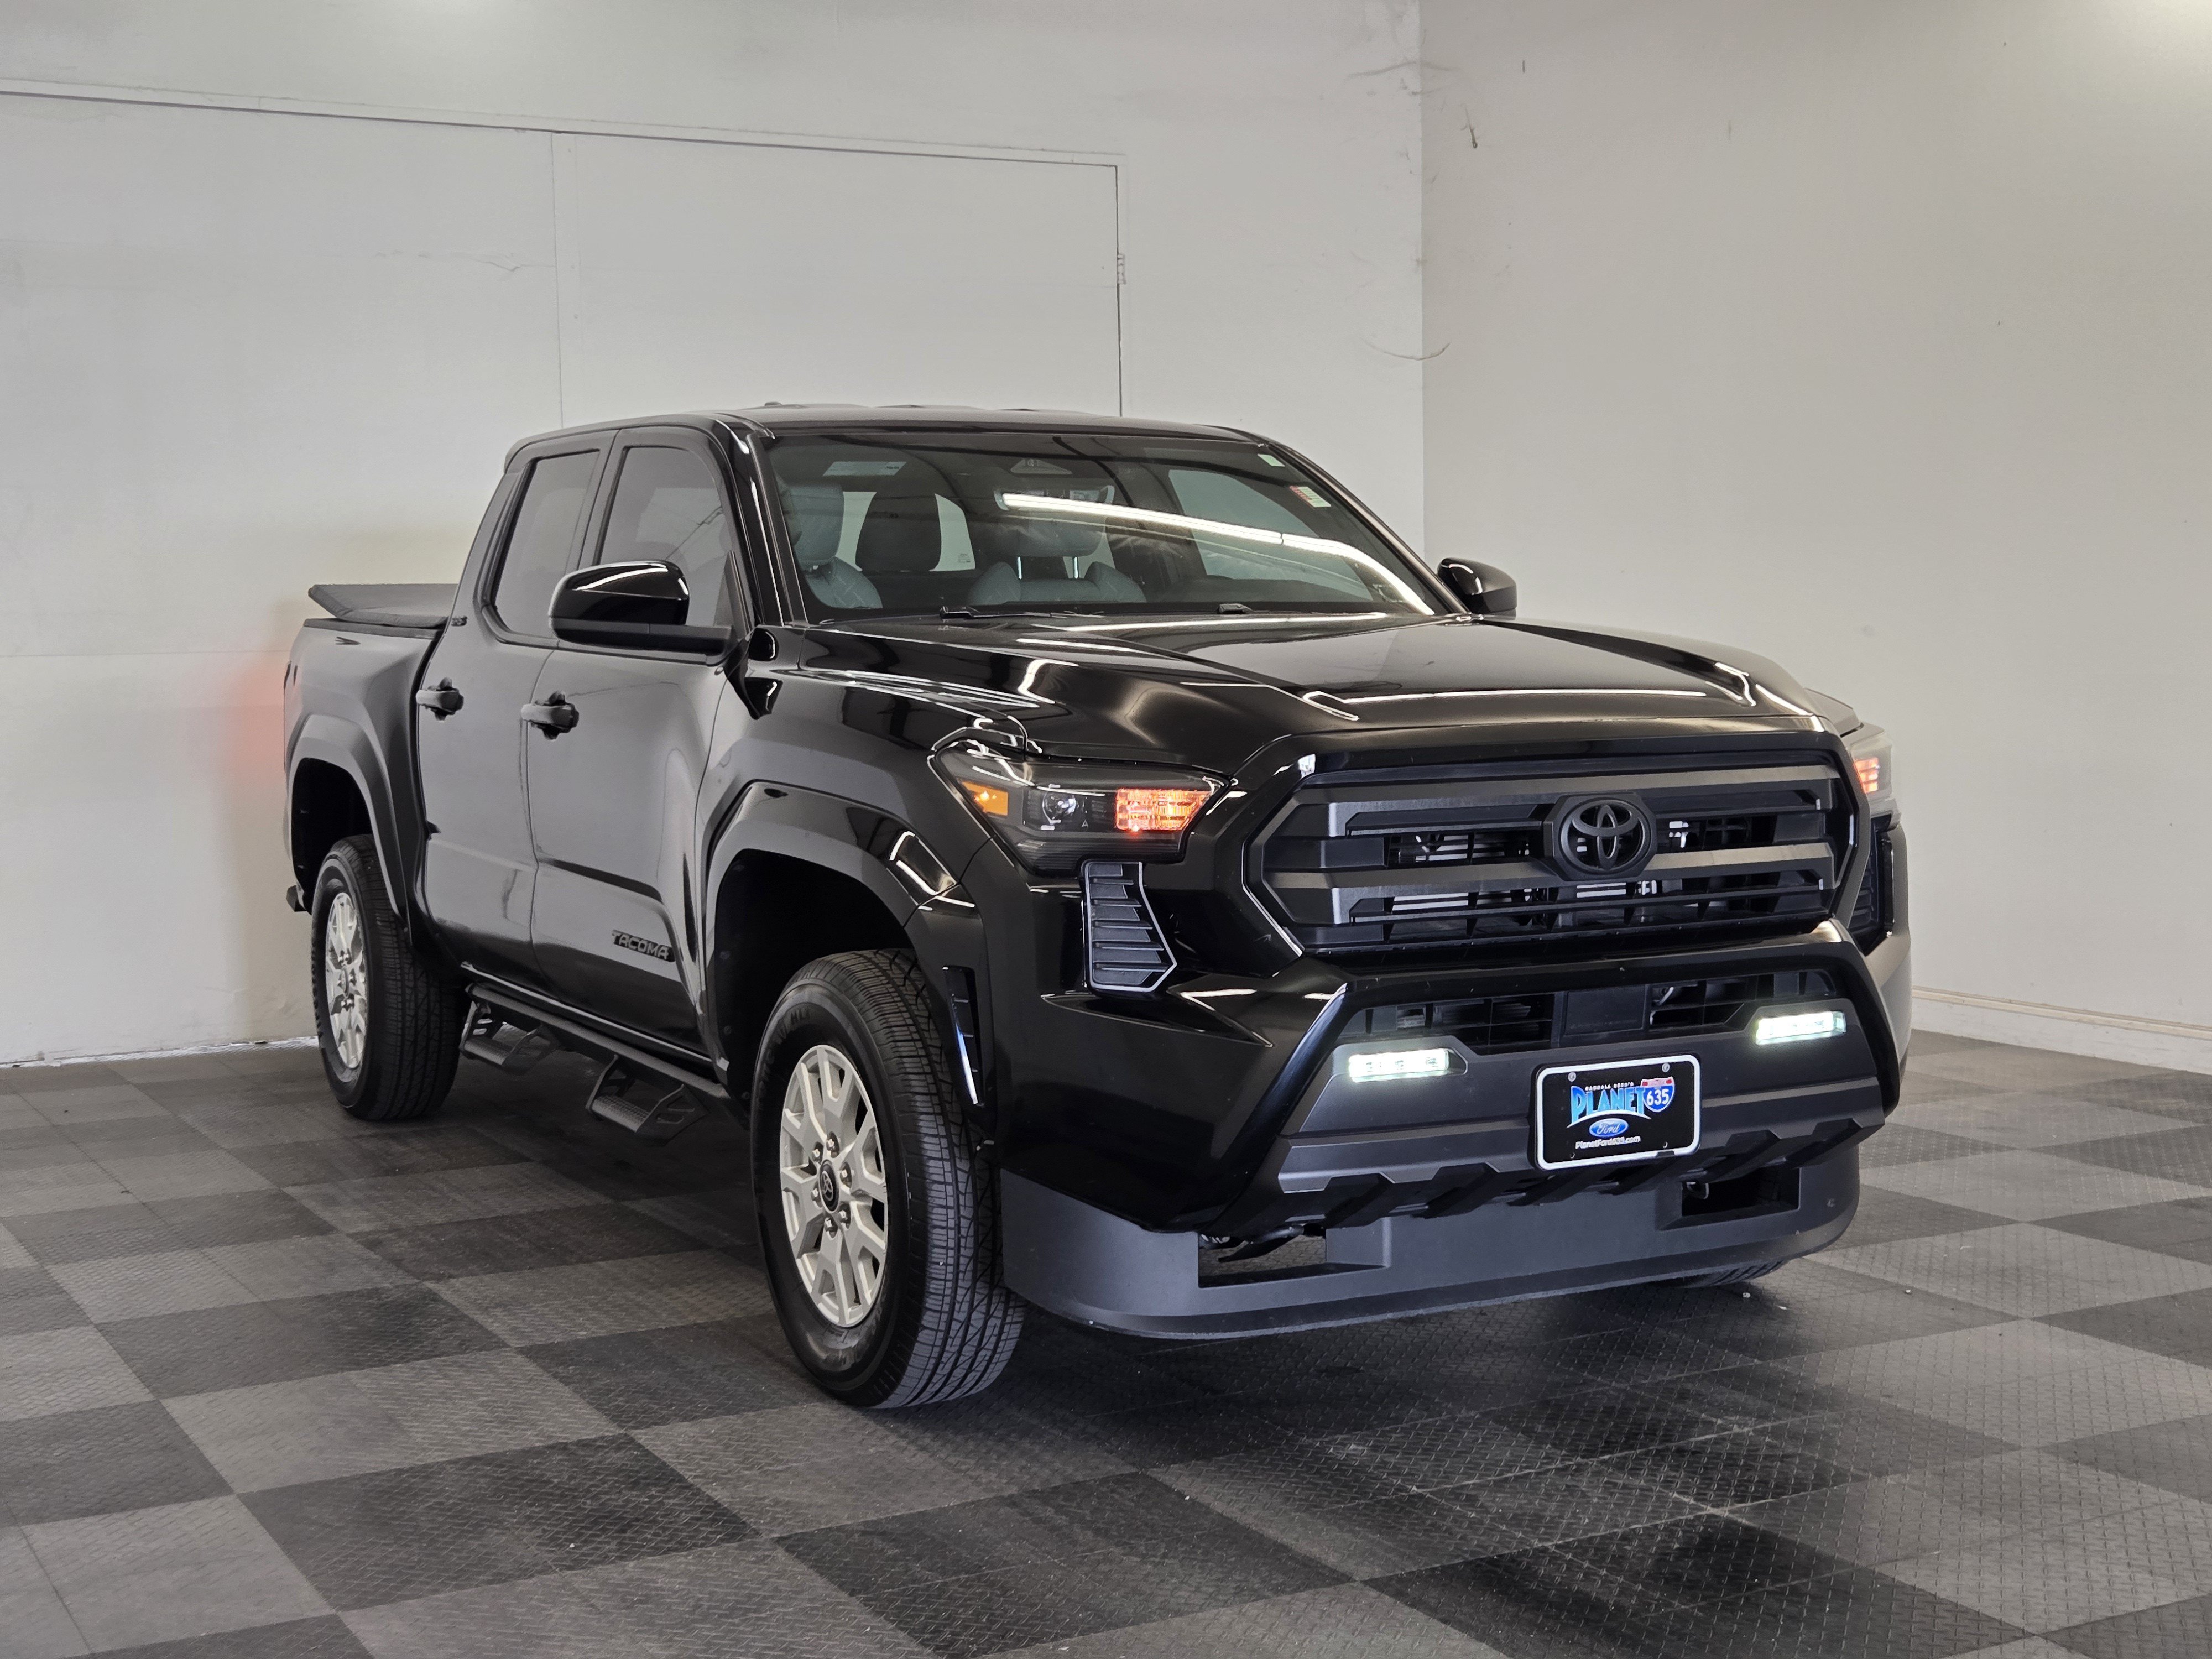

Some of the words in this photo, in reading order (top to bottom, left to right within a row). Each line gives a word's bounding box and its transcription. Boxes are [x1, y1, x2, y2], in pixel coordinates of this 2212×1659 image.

[611, 931, 669, 960] TACOMA
[1571, 1086, 1646, 1124] PLANET
[1646, 1088, 1669, 1106] 635
[1597, 1123, 1620, 1134] Ford
